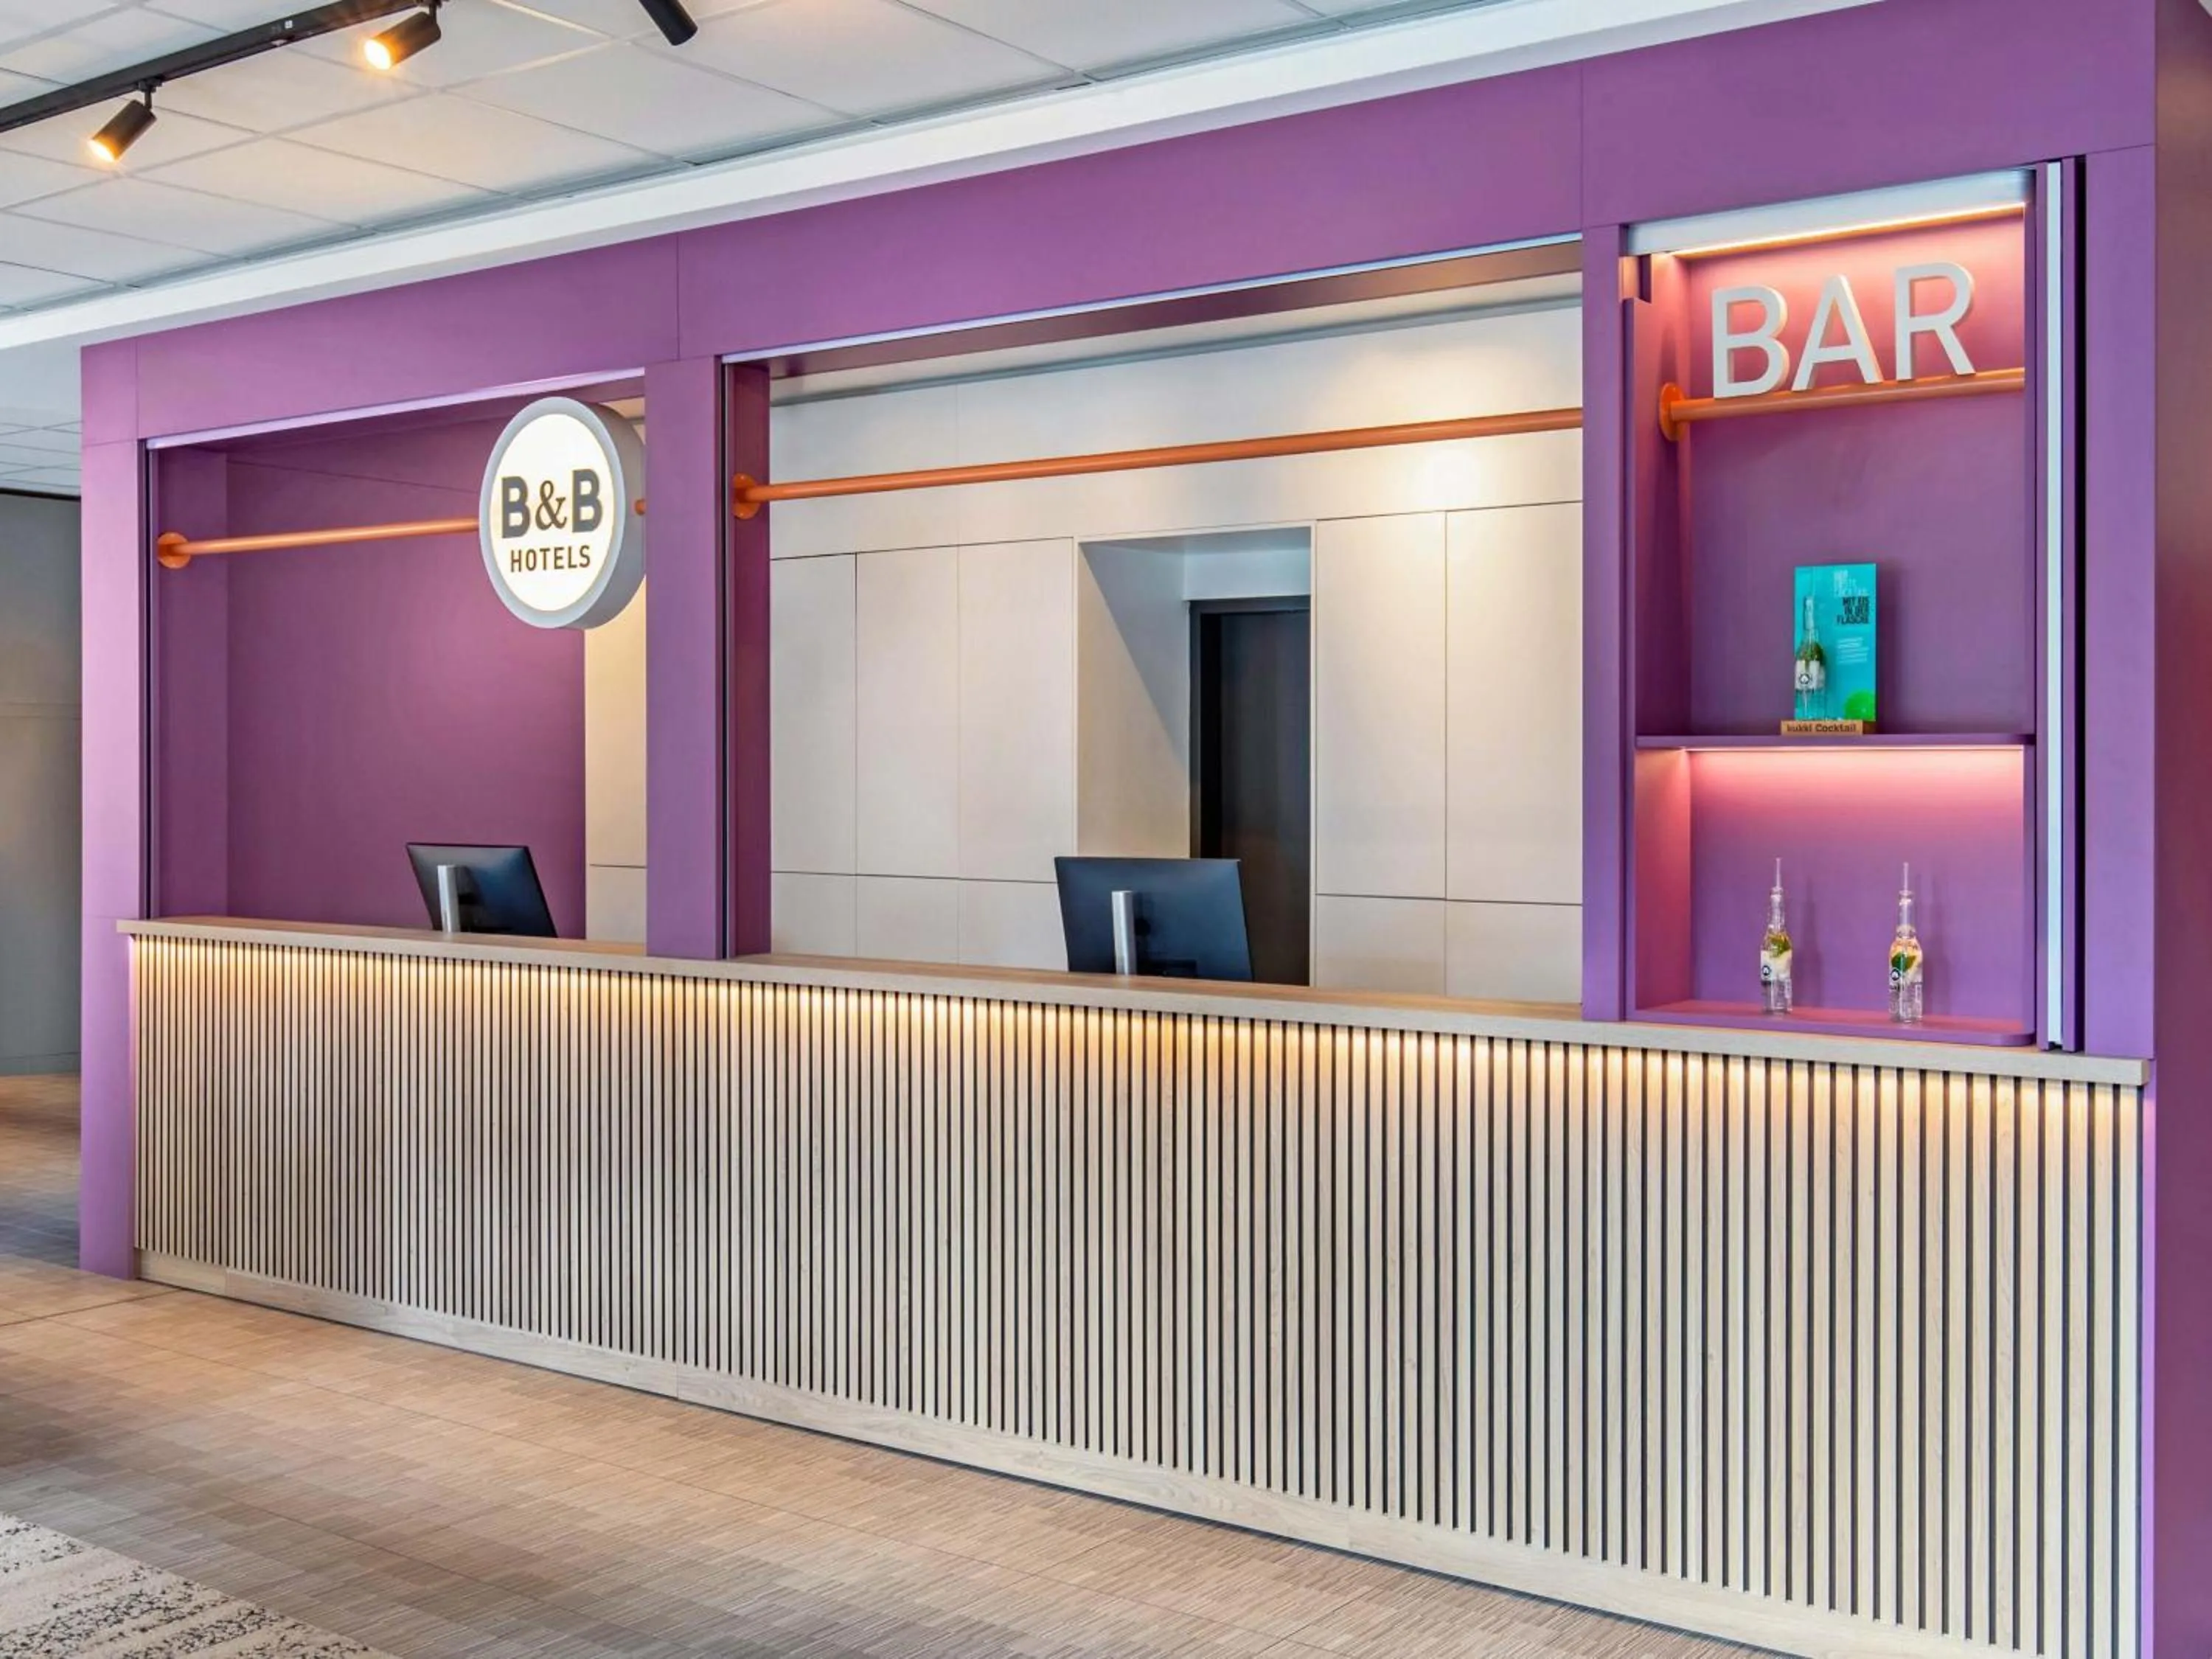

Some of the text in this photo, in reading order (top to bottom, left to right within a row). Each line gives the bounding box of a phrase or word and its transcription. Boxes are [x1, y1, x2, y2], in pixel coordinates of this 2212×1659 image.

[1711, 262, 1976, 399] BAR
[501, 468, 603, 539] B&B
[510, 545, 591, 573] HOTELS
[1815, 723, 1857, 732] Cocktail
